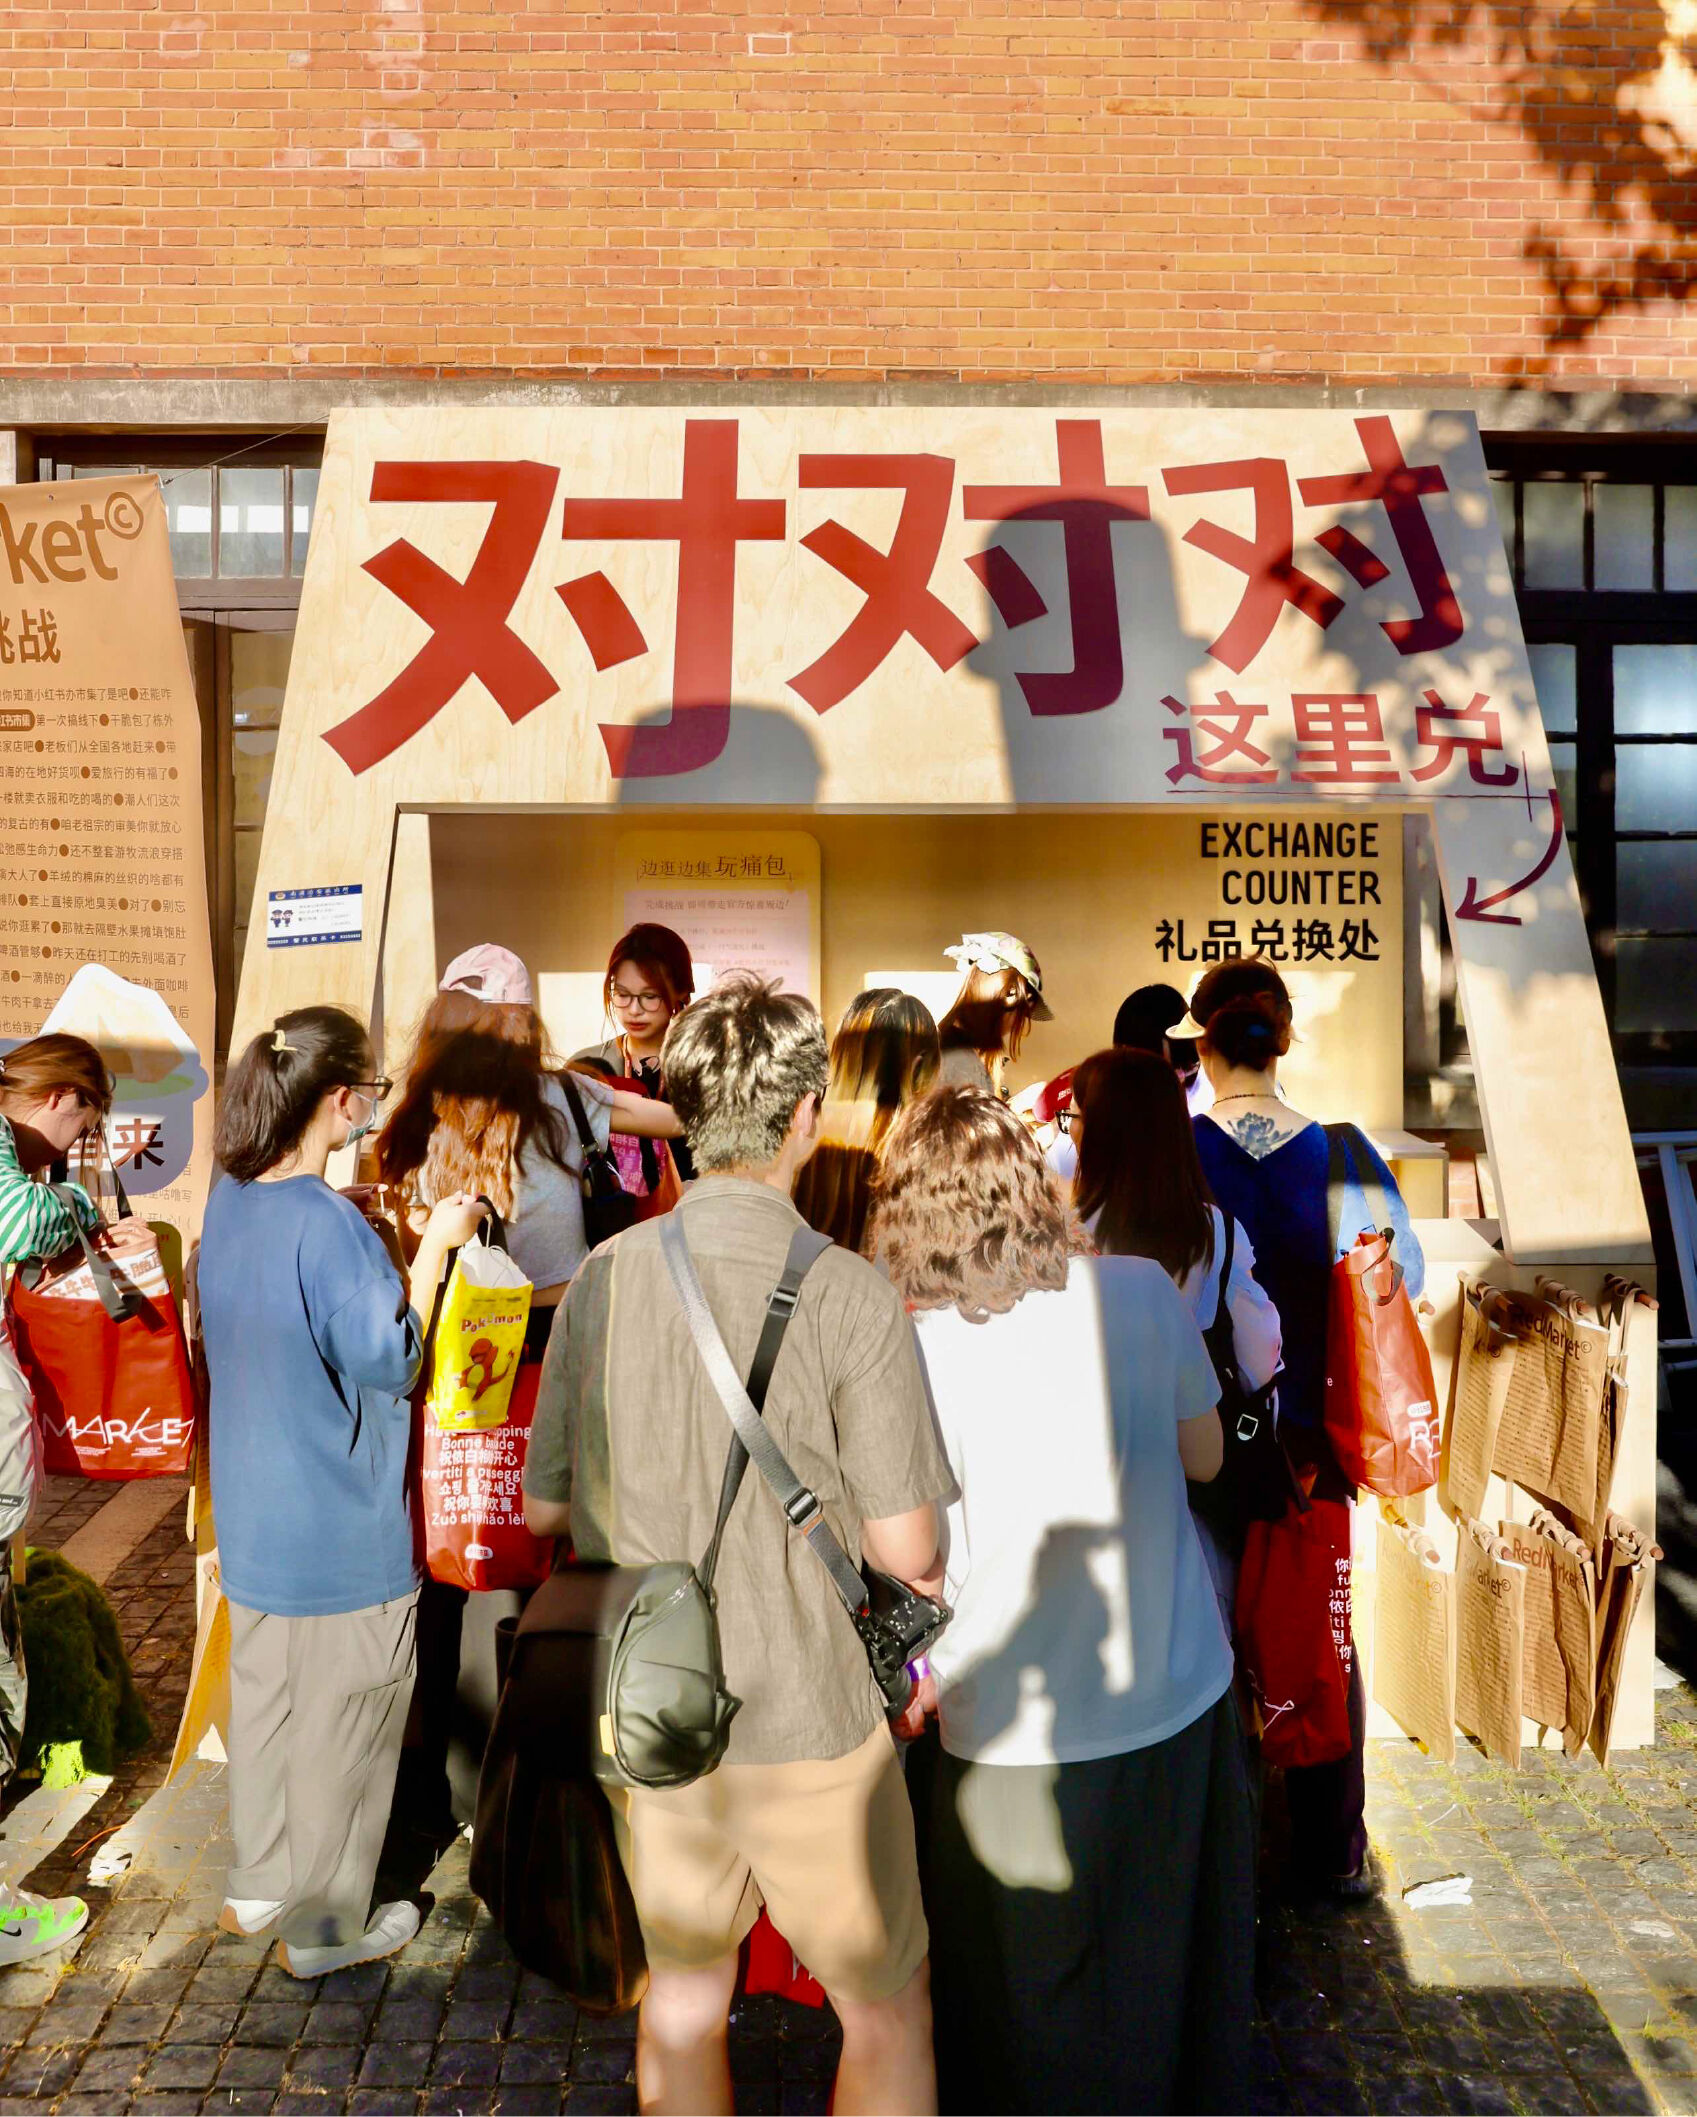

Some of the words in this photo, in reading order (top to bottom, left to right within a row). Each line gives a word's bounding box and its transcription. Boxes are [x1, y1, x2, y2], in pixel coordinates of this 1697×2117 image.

[0, 491, 144, 584] ket©
[320, 415, 1464, 779] 对对对
[0, 687, 129, 702] 你知道小红书办市集了是吧
[0, 740, 34, 753] 家店吧
[1160, 689, 1519, 786] 这里兑
[0, 792, 113, 807] 楼就卖衣服和吃的喝的
[1201, 822, 1379, 858] EXCHANGE
[1222, 870, 1381, 905] COUNTER
[1155, 919, 1380, 962] 礼品兑换处
[1, 995, 60, 1010] 牛肉干拿去
